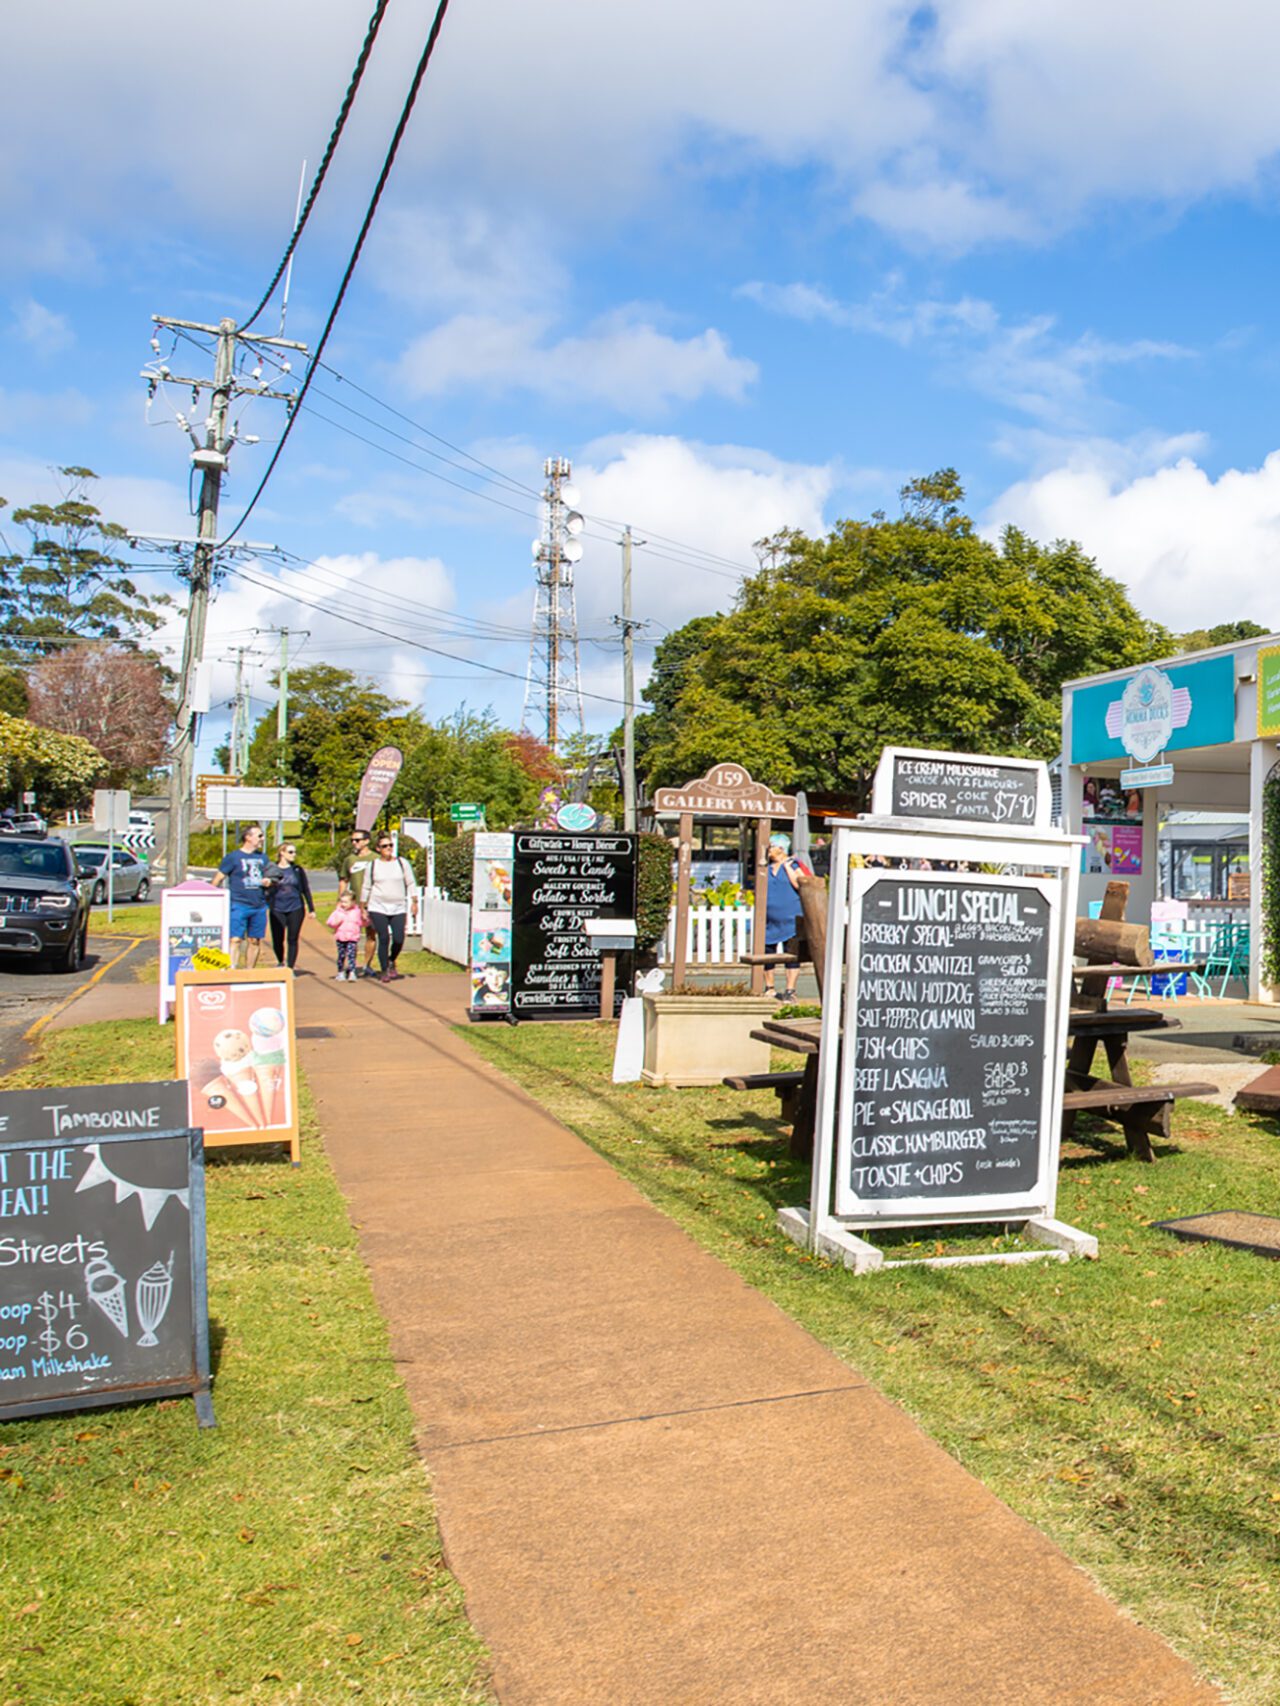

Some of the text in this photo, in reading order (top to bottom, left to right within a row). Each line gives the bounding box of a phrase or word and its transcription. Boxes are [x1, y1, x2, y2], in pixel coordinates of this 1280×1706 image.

[716, 771, 743, 787] 159
[946, 763, 1000, 778] MILKSHAKE
[941, 777, 961, 787] ANY
[963, 777, 971, 787] 2
[662, 794, 787, 813] GALLERY WALK
[899, 791, 948, 810] SPIDER
[956, 791, 989, 801] COKE
[955, 803, 990, 815] FANTA
[532, 860, 568, 876] Sweets
[580, 860, 616, 879] Candy
[572, 882, 606, 890] GOURMET
[532, 888, 568, 905] Gelato
[579, 888, 616, 904] Sorbet
[898, 887, 1025, 926] LUNCH SPECIAL
[169, 927, 221, 936] COLD DRINKS
[539, 915, 565, 931] Soft
[912, 924, 955, 948] SPECIAL
[544, 943, 601, 958] Soft Serve
[861, 953, 911, 974] CHICKEN
[524, 970, 570, 985] Sundaes
[857, 979, 917, 1002] AMERICAN
[857, 1007, 881, 1028] SALT
[886, 1007, 920, 1030] PEPPER
[920, 1008, 976, 1030] CALAMARI
[855, 1037, 886, 1061] FISH
[892, 1036, 930, 1061] CHIPS
[969, 1034, 1000, 1049] SALAD
[1007, 1034, 1034, 1048] CHIPS
[983, 1062, 1019, 1078] SALAD
[854, 1068, 882, 1092] BEEF
[984, 1073, 1016, 1089] CHIPS
[854, 1100, 876, 1127] PIE
[890, 1097, 949, 1125] SAUSAGE
[949, 1098, 975, 1120] ROLL
[852, 1128, 987, 1158] CLASSIC HAMBURGER
[25, 1147, 76, 1181] THE
[920, 1160, 964, 1186] CHIPS
[0, 1184, 48, 1217] EAT!
[0, 1234, 108, 1266] Streets
[31, 1352, 112, 1378] Milkshake
